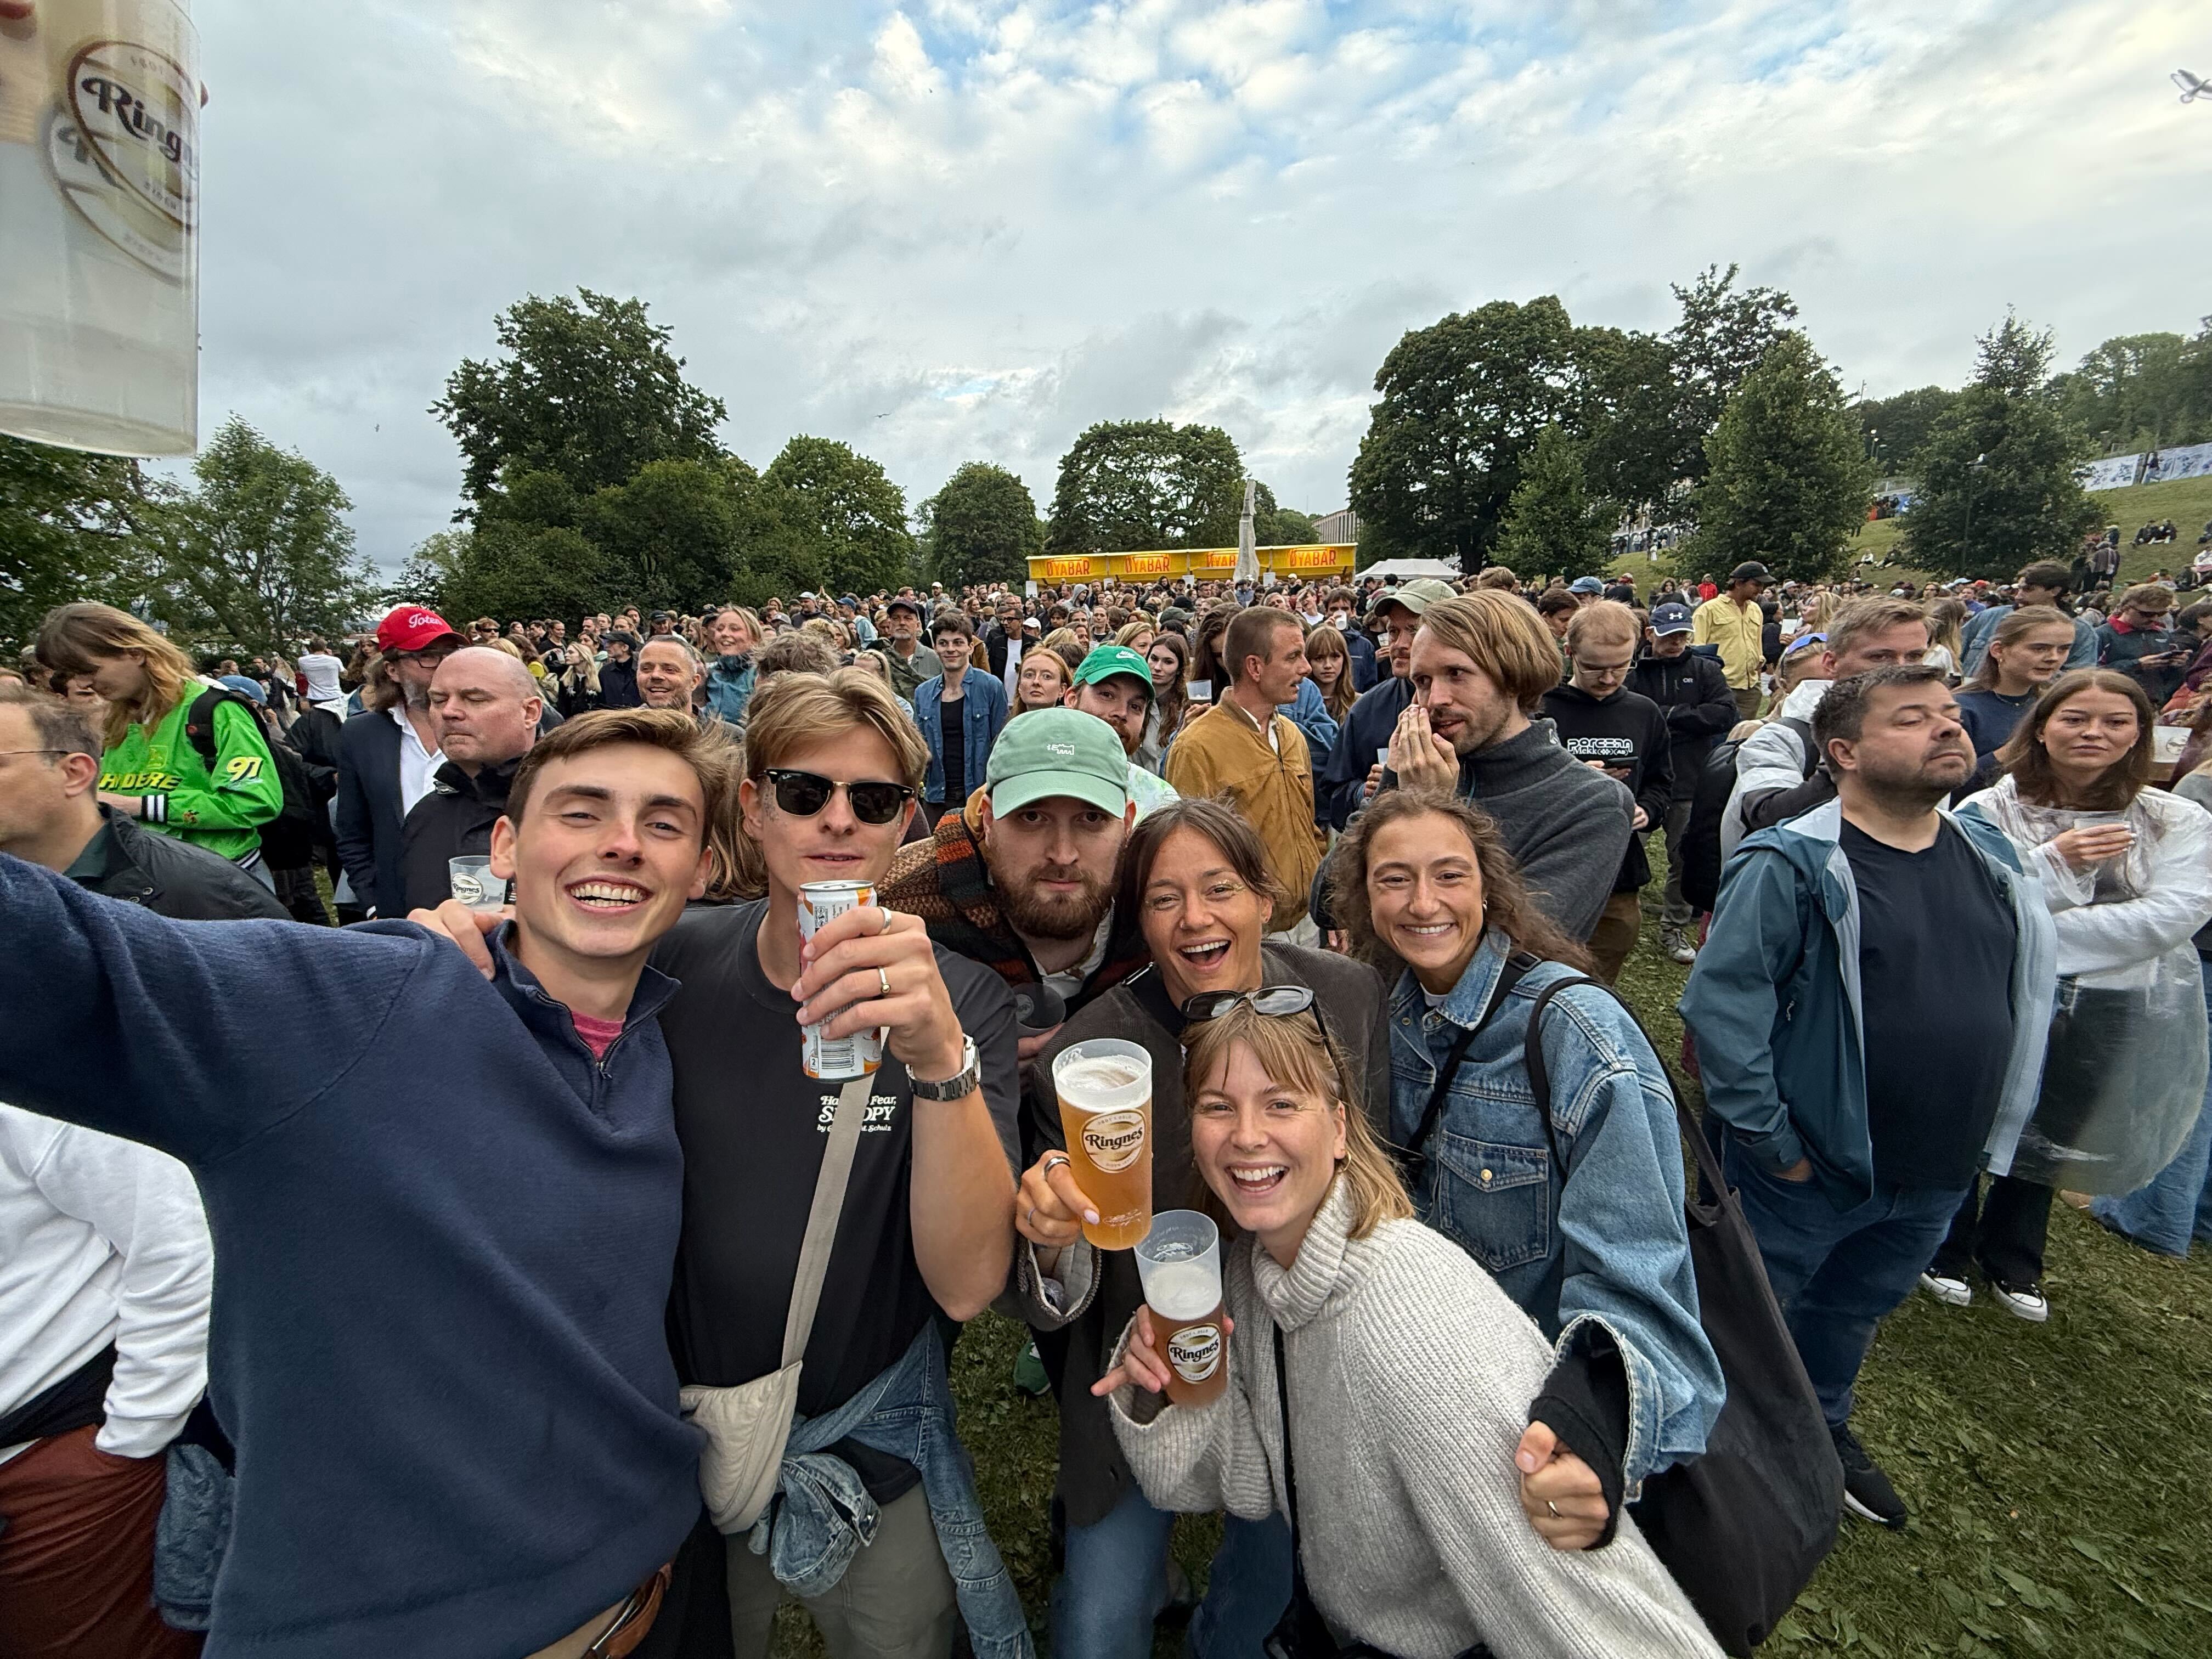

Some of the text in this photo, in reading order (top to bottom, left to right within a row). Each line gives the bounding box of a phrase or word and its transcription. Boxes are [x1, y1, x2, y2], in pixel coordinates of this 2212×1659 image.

[1046, 560, 1090, 576] ØYABAR
[1125, 555, 1170, 573] ØYABAR
[870, 1095, 897, 1105] Fear,
[868, 1124, 891, 1133] Schulz
[1085, 1127, 1143, 1150] Ringnes
[1170, 1339, 1219, 1362] Ringnes
